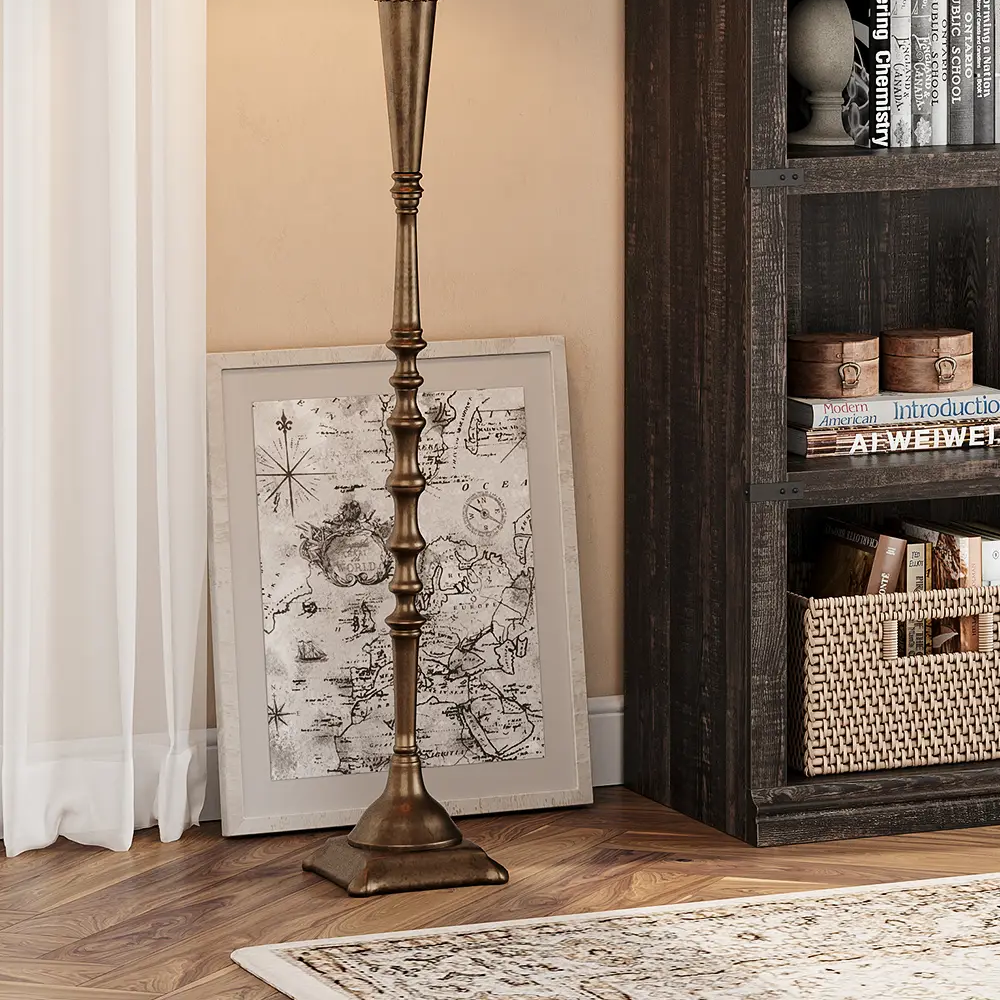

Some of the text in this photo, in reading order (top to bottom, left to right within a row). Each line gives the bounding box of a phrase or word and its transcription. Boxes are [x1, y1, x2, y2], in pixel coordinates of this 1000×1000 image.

[964, 12, 972, 78] ONTARIO
[984, 46, 990, 54] a
[872, 50, 891, 147] Chemistry
[931, 51, 939, 106] SCHOOL
[952, 46, 961, 104] SCHOOL
[983, 56, 992, 97] Nation
[819, 413, 877, 426] American
[823, 403, 868, 415] Modern
